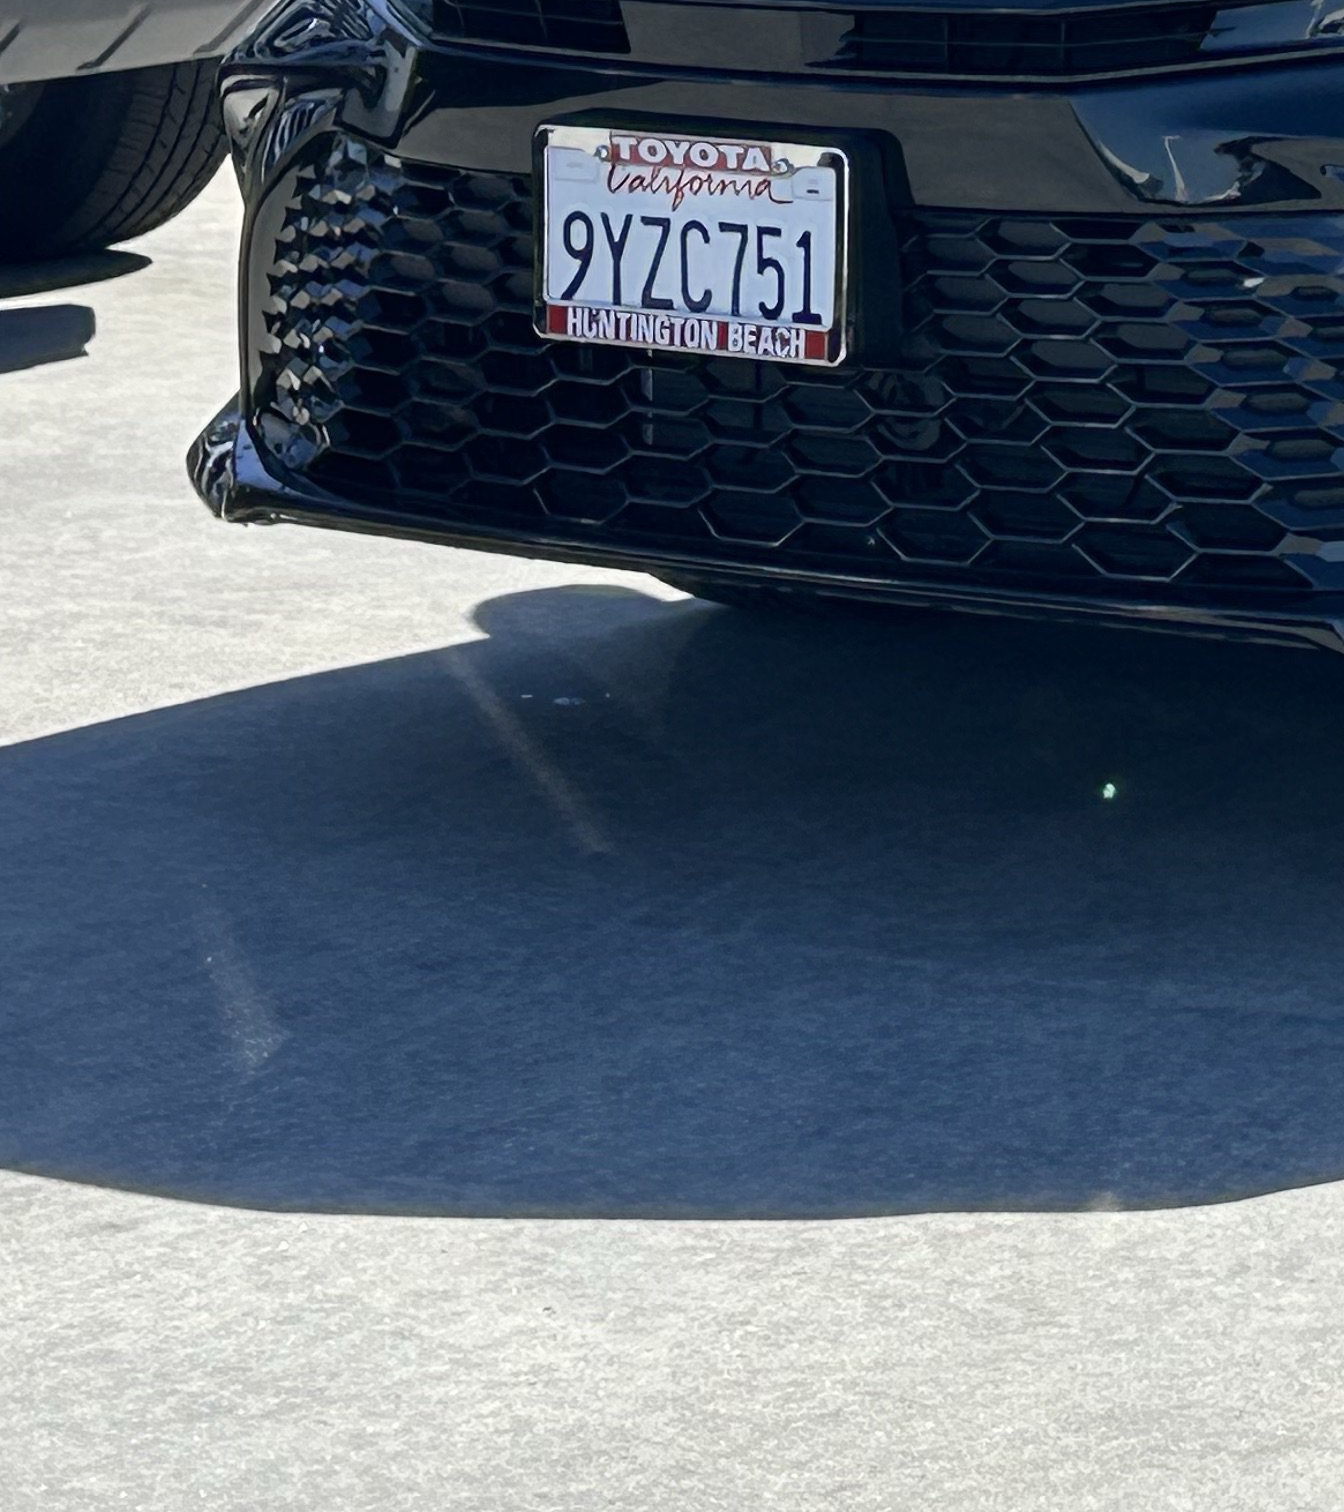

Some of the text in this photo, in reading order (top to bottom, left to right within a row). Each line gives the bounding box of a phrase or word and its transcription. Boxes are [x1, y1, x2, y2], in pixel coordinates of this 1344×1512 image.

[611, 135, 771, 173] TOYOTA
[607, 164, 794, 211] California
[559, 209, 824, 326] 9YZC751
[565, 305, 806, 359] HUNTINGTON BEACH
